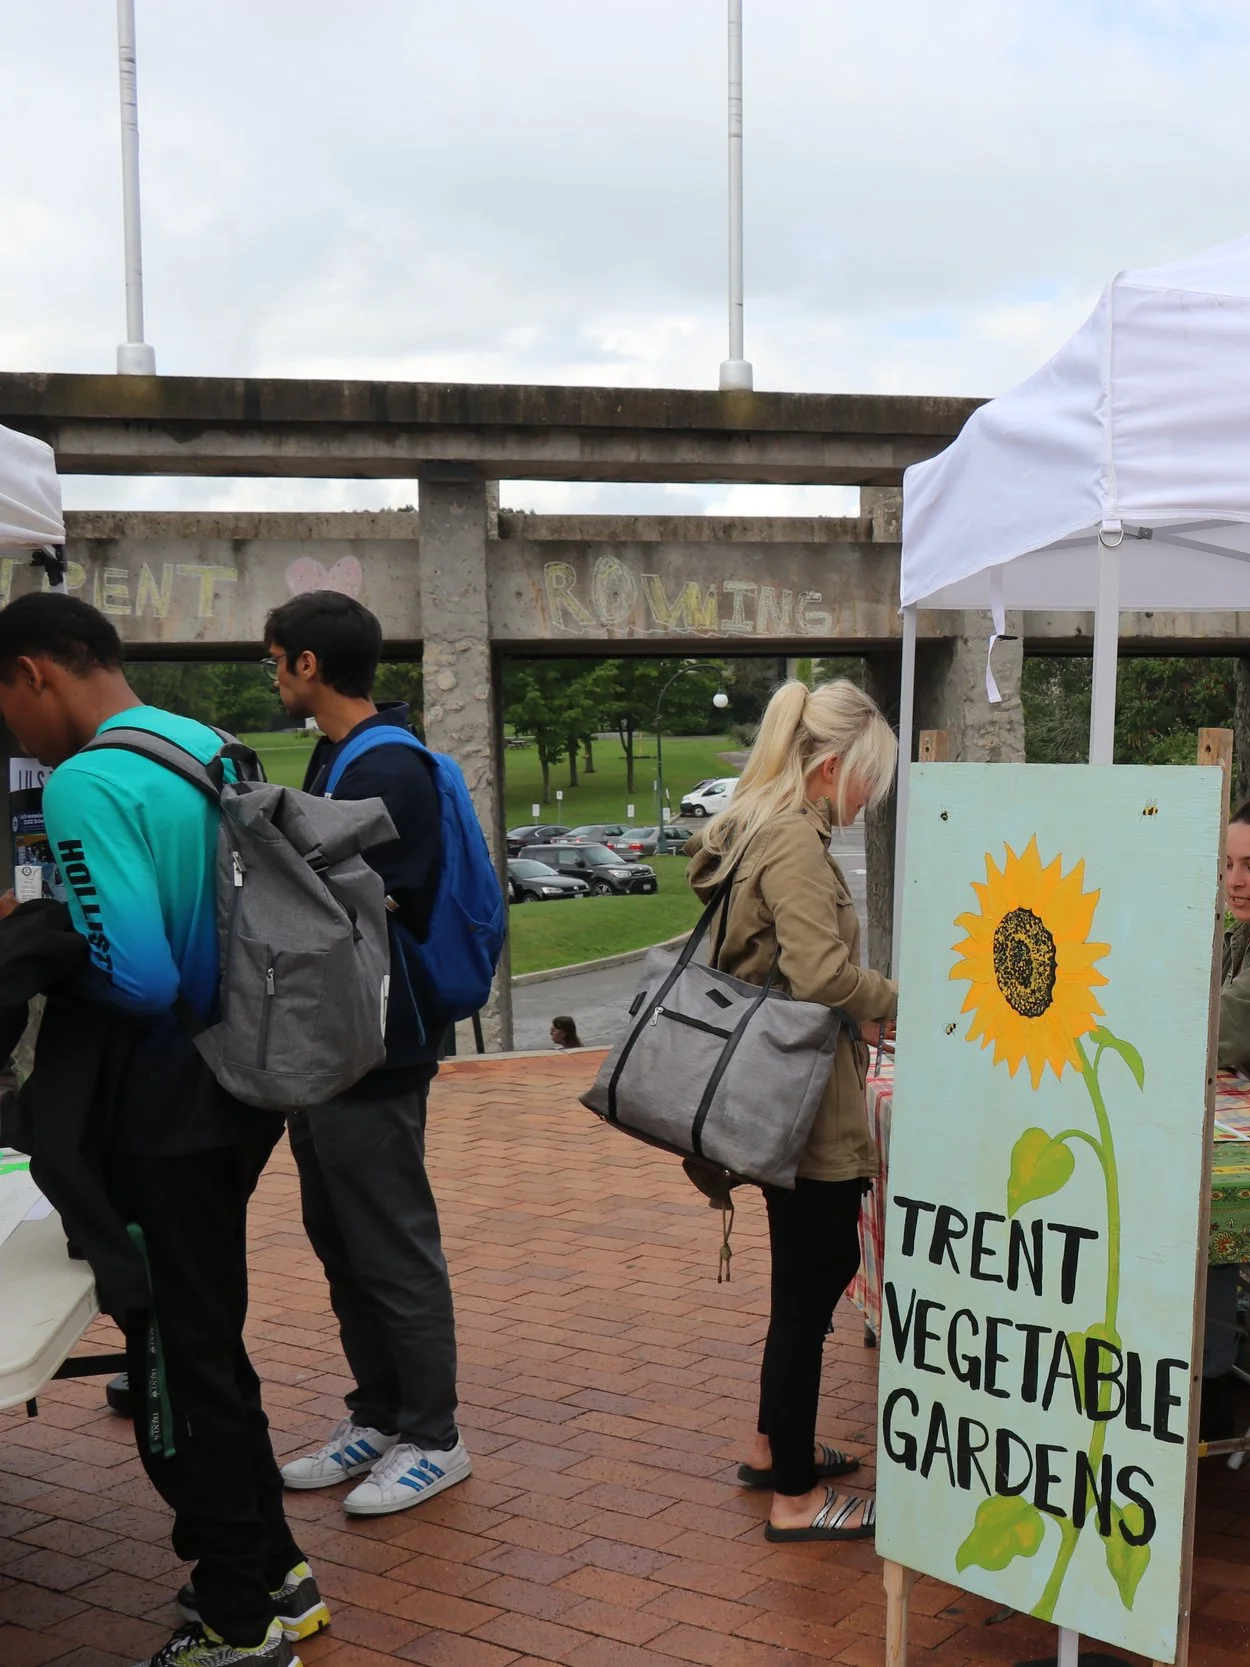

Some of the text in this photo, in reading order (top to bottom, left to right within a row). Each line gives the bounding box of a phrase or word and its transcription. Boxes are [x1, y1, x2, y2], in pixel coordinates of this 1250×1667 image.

[544, 555, 833, 636] ROWING
[893, 1195, 1099, 1305] TRENT
[884, 1281, 1190, 1445] VEGETABLE
[882, 1387, 1157, 1547] GARDENS
